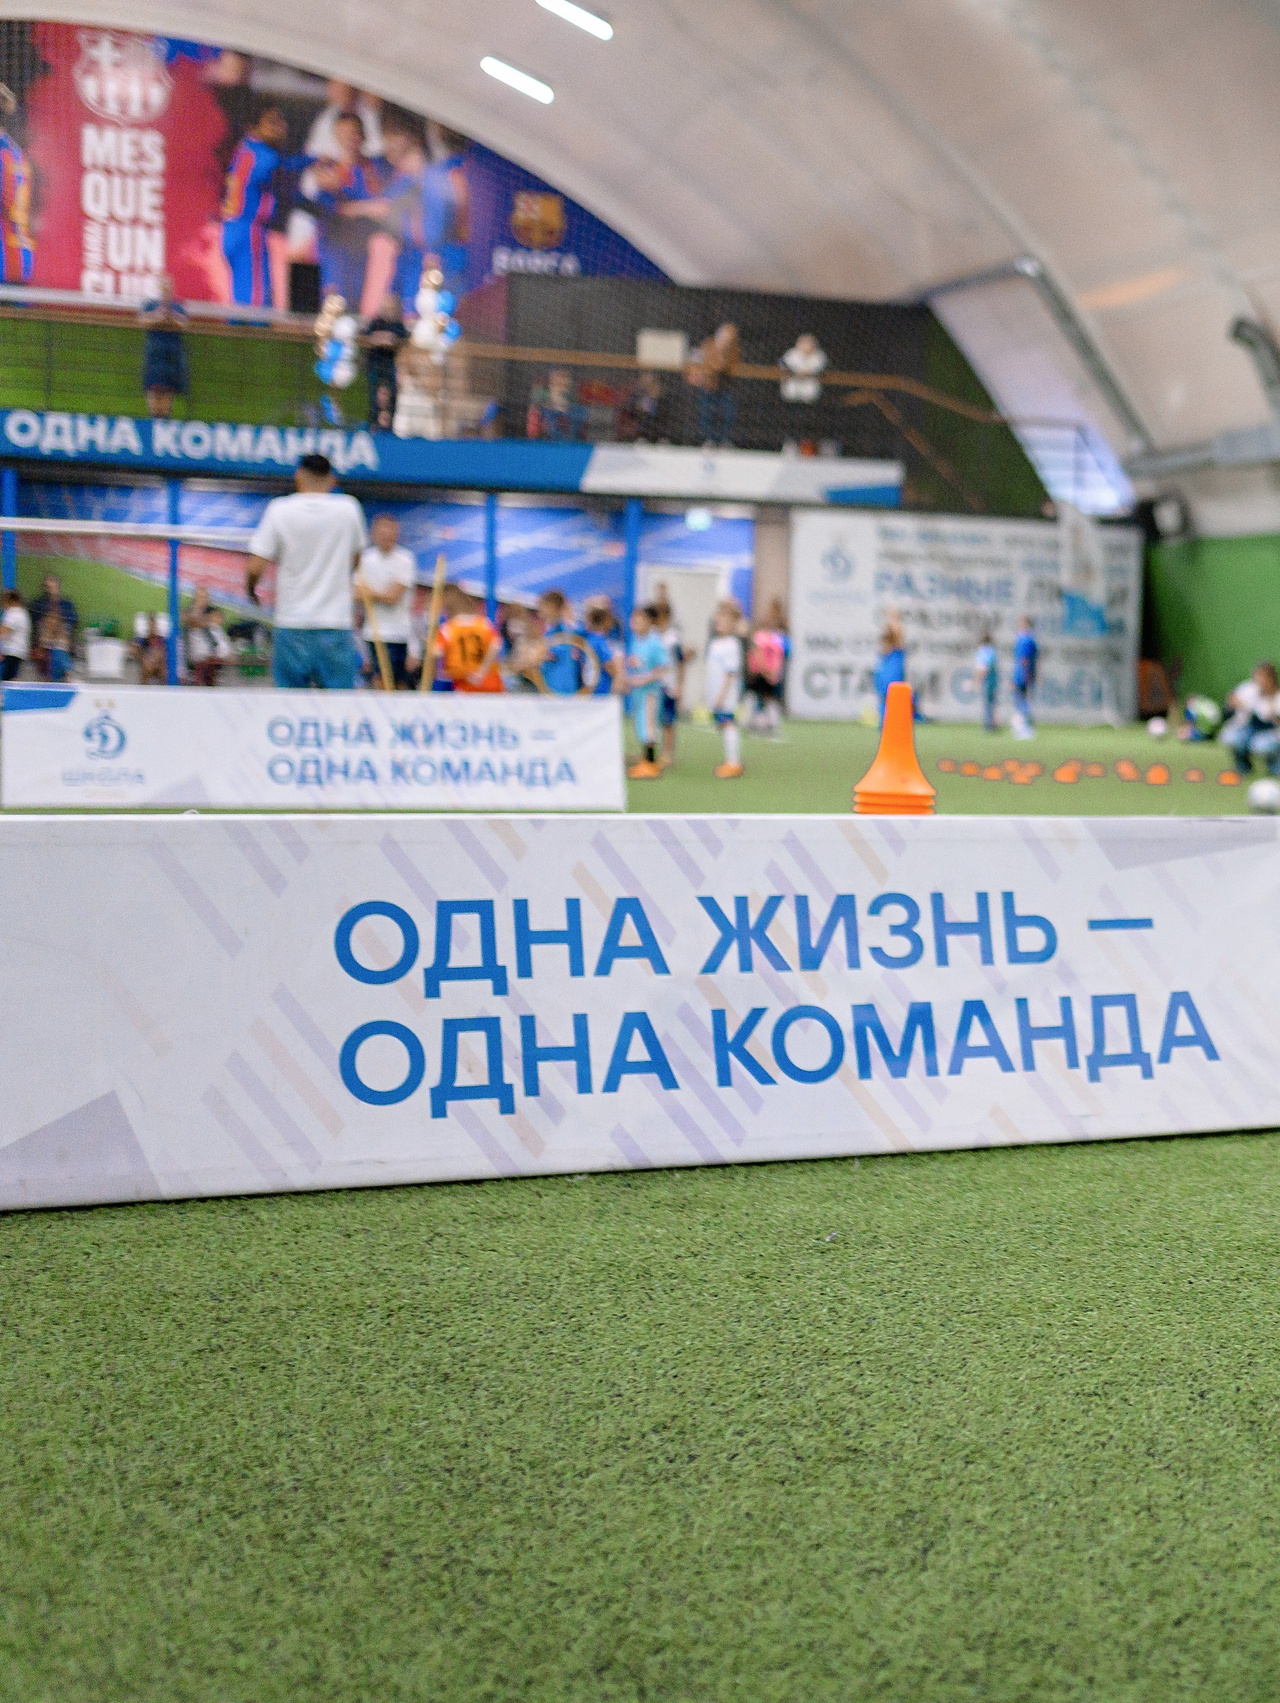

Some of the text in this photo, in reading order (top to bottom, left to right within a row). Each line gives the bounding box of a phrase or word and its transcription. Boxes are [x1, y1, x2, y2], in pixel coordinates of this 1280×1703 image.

[80, 170, 166, 225] QUE
[106, 222, 166, 274] UN
[4, 409, 380, 474] ОДНА КОМАНДА
[458, 632, 485, 665] 13
[266, 714, 377, 749] ОДНА
[390, 716, 521, 750] ЖИЗНЬ
[266, 753, 579, 789] ОДНА КОМАНДА
[333, 896, 671, 1000] ОДНА
[697, 891, 1059, 975] ЖИЗНЬ
[338, 991, 1221, 1120] ОДНА КОМАНДА
